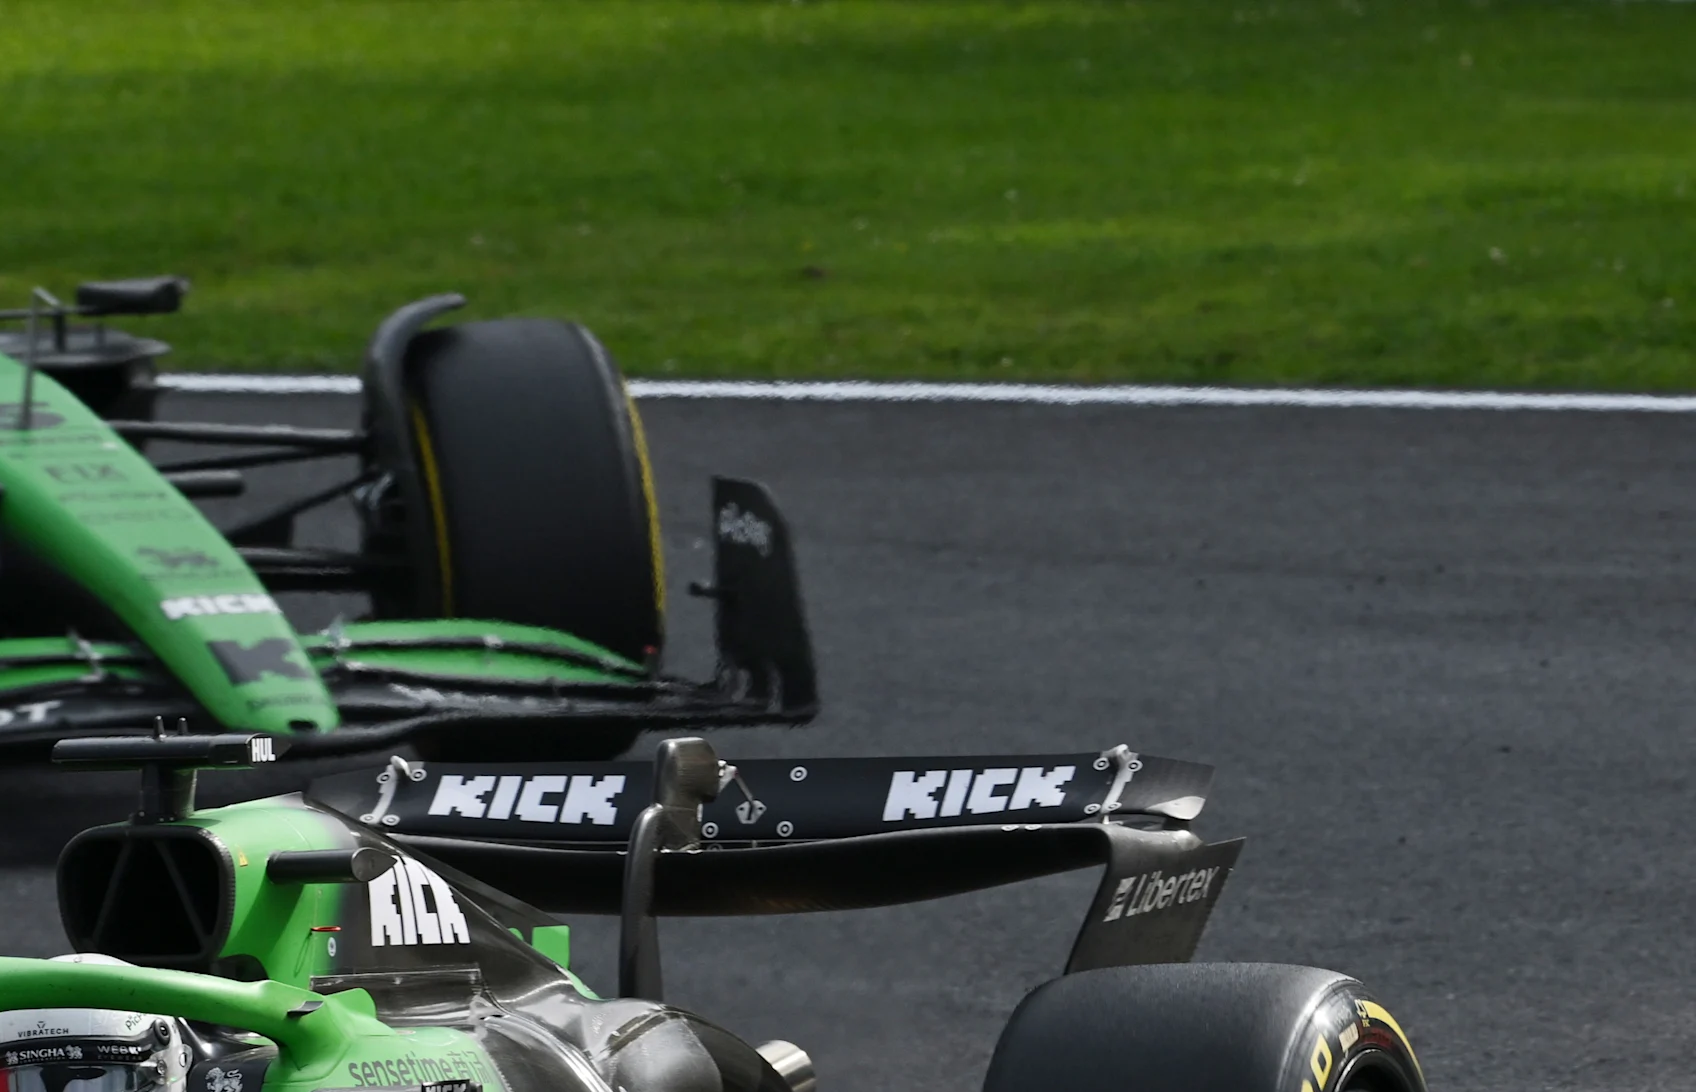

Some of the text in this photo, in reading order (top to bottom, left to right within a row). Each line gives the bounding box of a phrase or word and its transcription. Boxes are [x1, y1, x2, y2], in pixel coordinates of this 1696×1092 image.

[160, 593, 285, 621] KICK
[251, 737, 276, 762] HUL
[427, 774, 626, 826] KICK
[882, 765, 1076, 823] KICK
[367, 854, 471, 947] KICK
[1125, 866, 1220, 917] Libertex
[17, 1027, 69, 1038] VIBRATECH
[19, 1047, 66, 1060] SINGHA
[348, 1050, 456, 1087] sensetime
